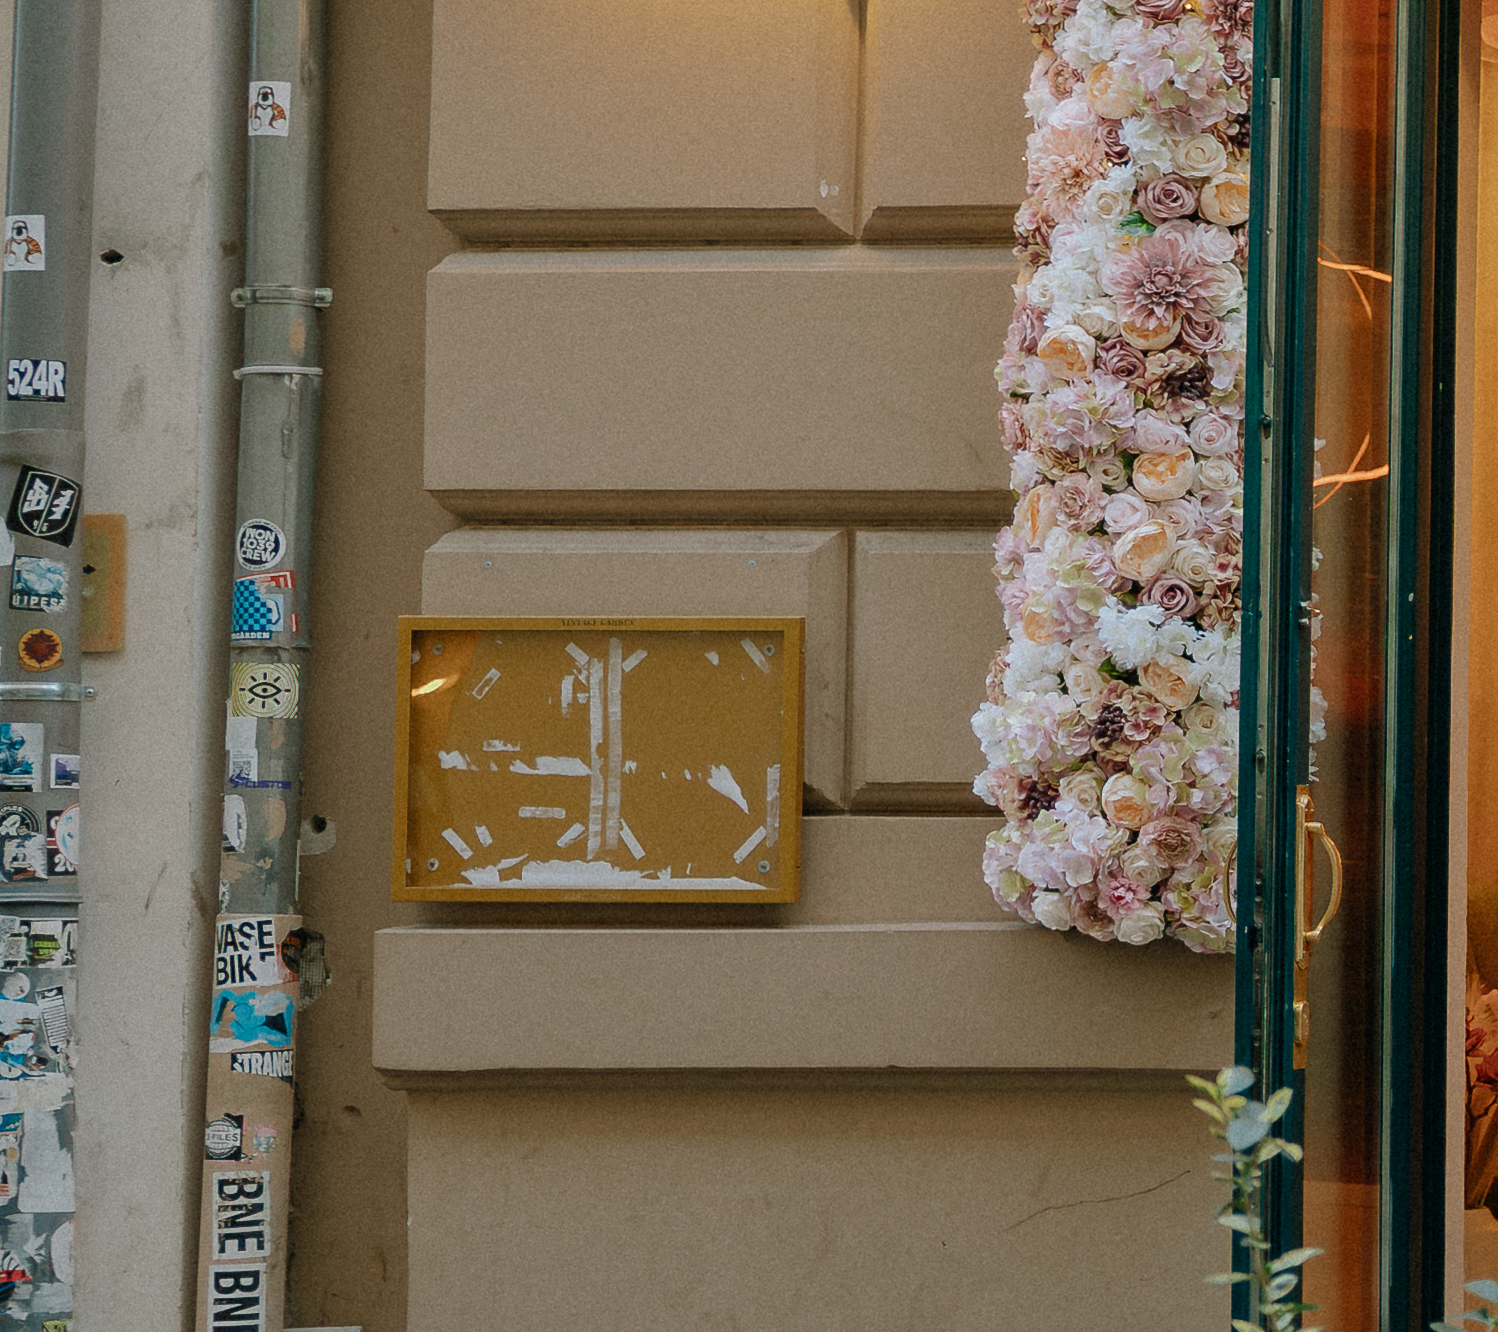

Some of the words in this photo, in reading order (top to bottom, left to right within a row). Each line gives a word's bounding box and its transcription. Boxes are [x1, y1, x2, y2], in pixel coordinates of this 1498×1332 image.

[7, 358, 65, 397] 524R
[240, 547, 276, 563] CREW
[242, 537, 276, 552] 1039
[217, 1176, 265, 1254] BNE
